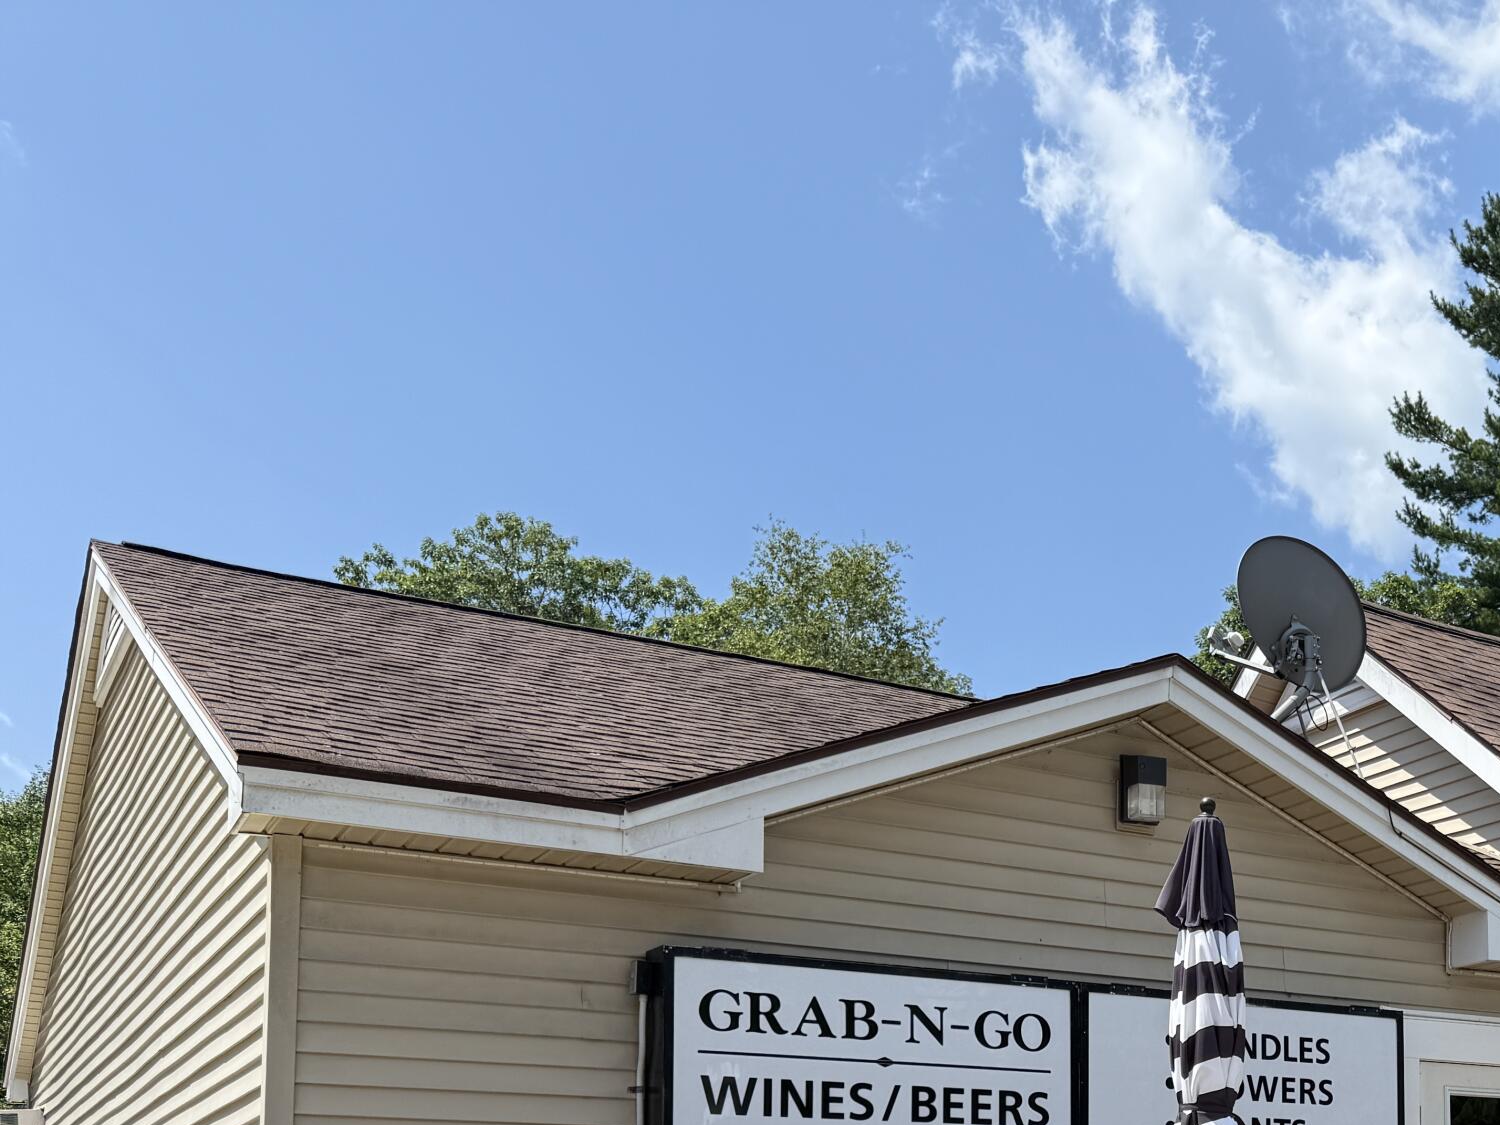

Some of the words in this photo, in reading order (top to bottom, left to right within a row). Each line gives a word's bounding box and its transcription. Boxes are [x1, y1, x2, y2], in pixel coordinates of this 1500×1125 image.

[698, 988, 1052, 1053] GRAB-N-GO
[1244, 1032, 1331, 1065] NDLES
[1237, 1074, 1334, 1106] WERS
